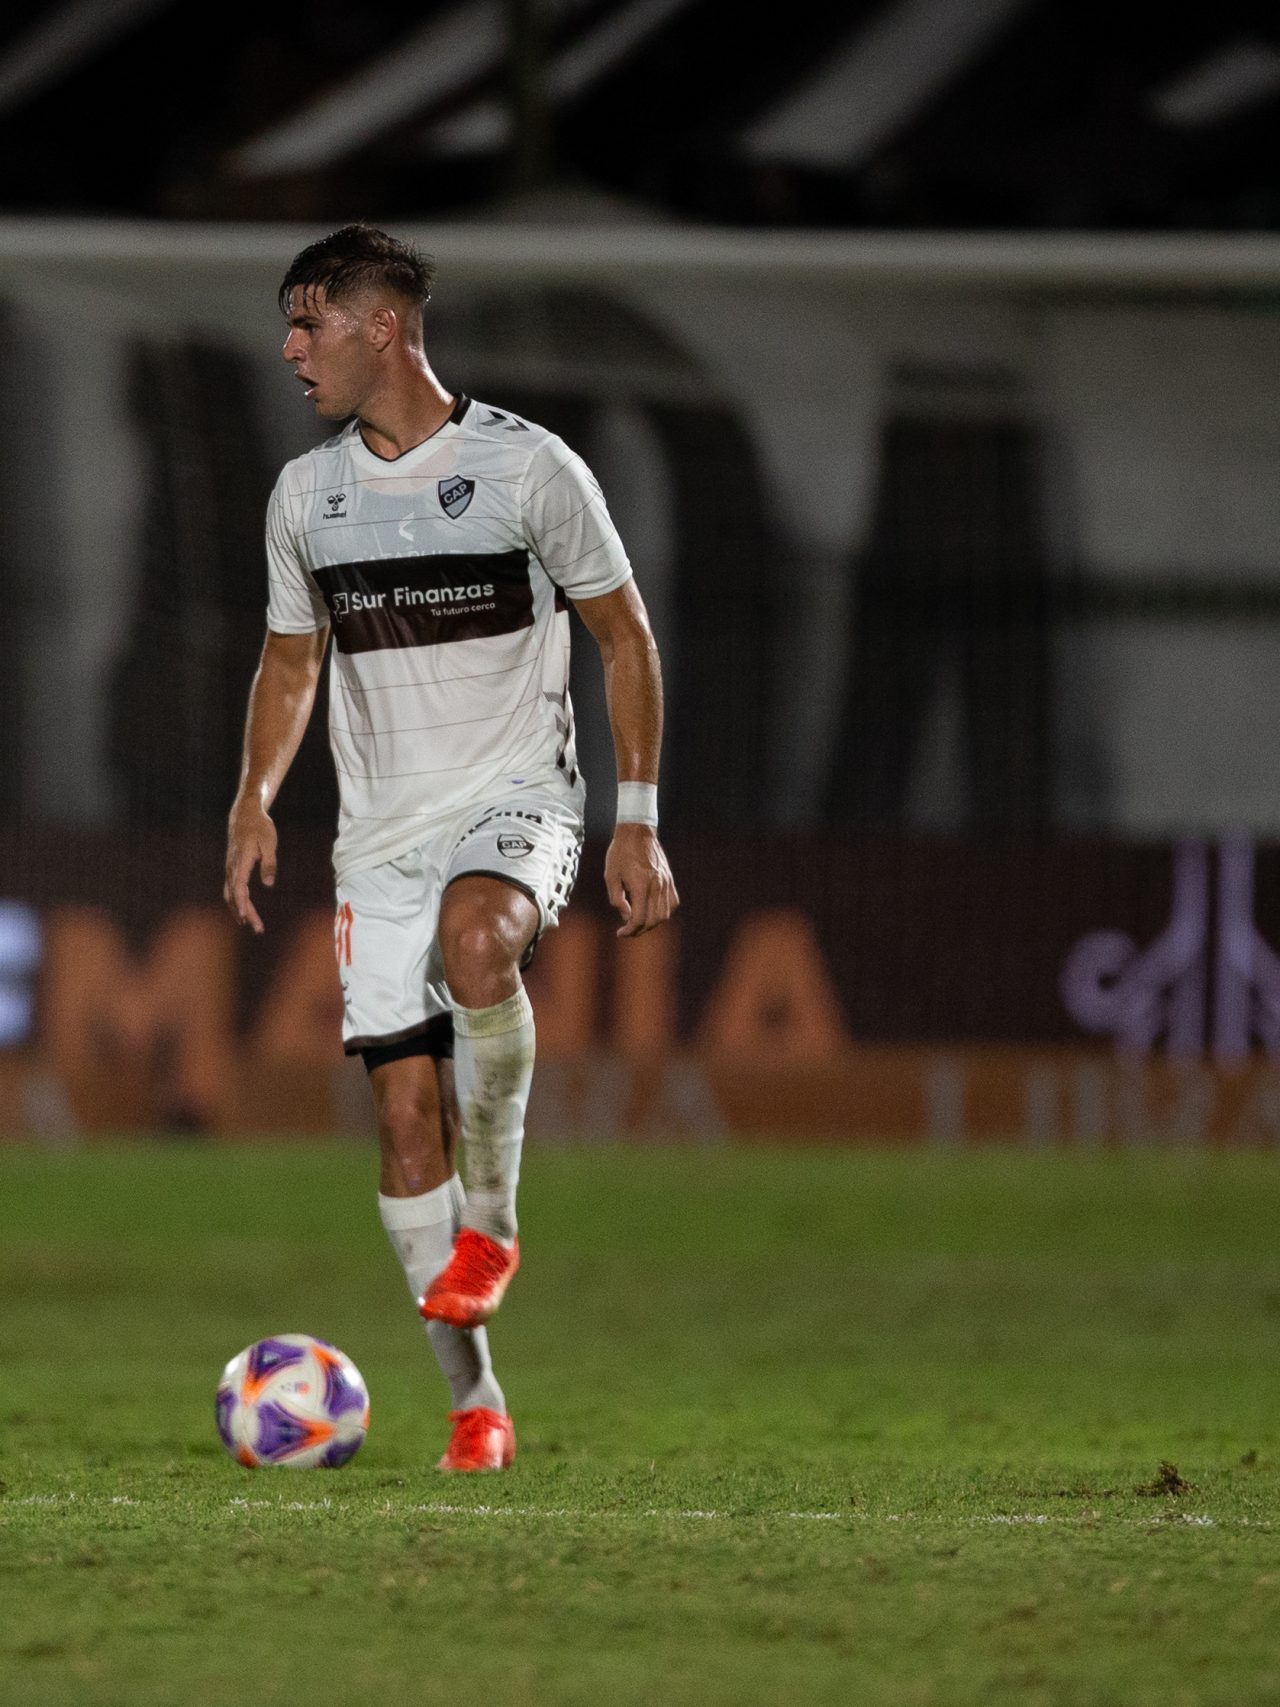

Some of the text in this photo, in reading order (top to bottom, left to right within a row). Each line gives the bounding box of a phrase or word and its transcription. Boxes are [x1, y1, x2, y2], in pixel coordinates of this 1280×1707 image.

[442, 484, 468, 504] CAP
[351, 583, 495, 611] Sur Finanzas
[430, 602, 496, 617] Tu futuro cerca
[501, 841, 527, 849] CAP
